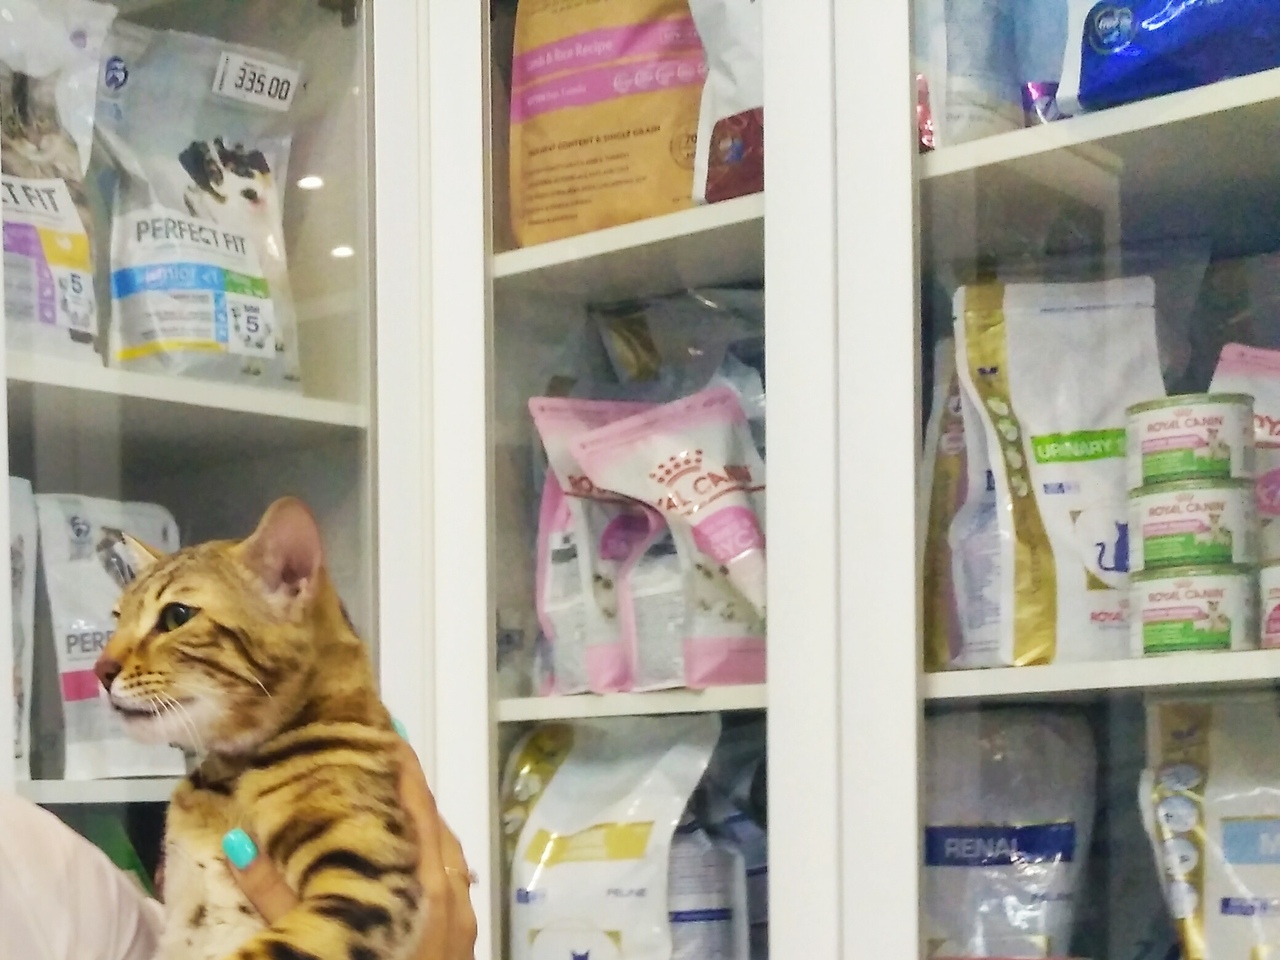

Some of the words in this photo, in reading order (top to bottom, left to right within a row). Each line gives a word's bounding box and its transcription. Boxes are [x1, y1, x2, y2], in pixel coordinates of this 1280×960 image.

[21, 185, 59, 213] FIT
[136, 218, 220, 249] PERFECT
[221, 233, 246, 255] FIT
[944, 838, 1019, 860] RENAL
